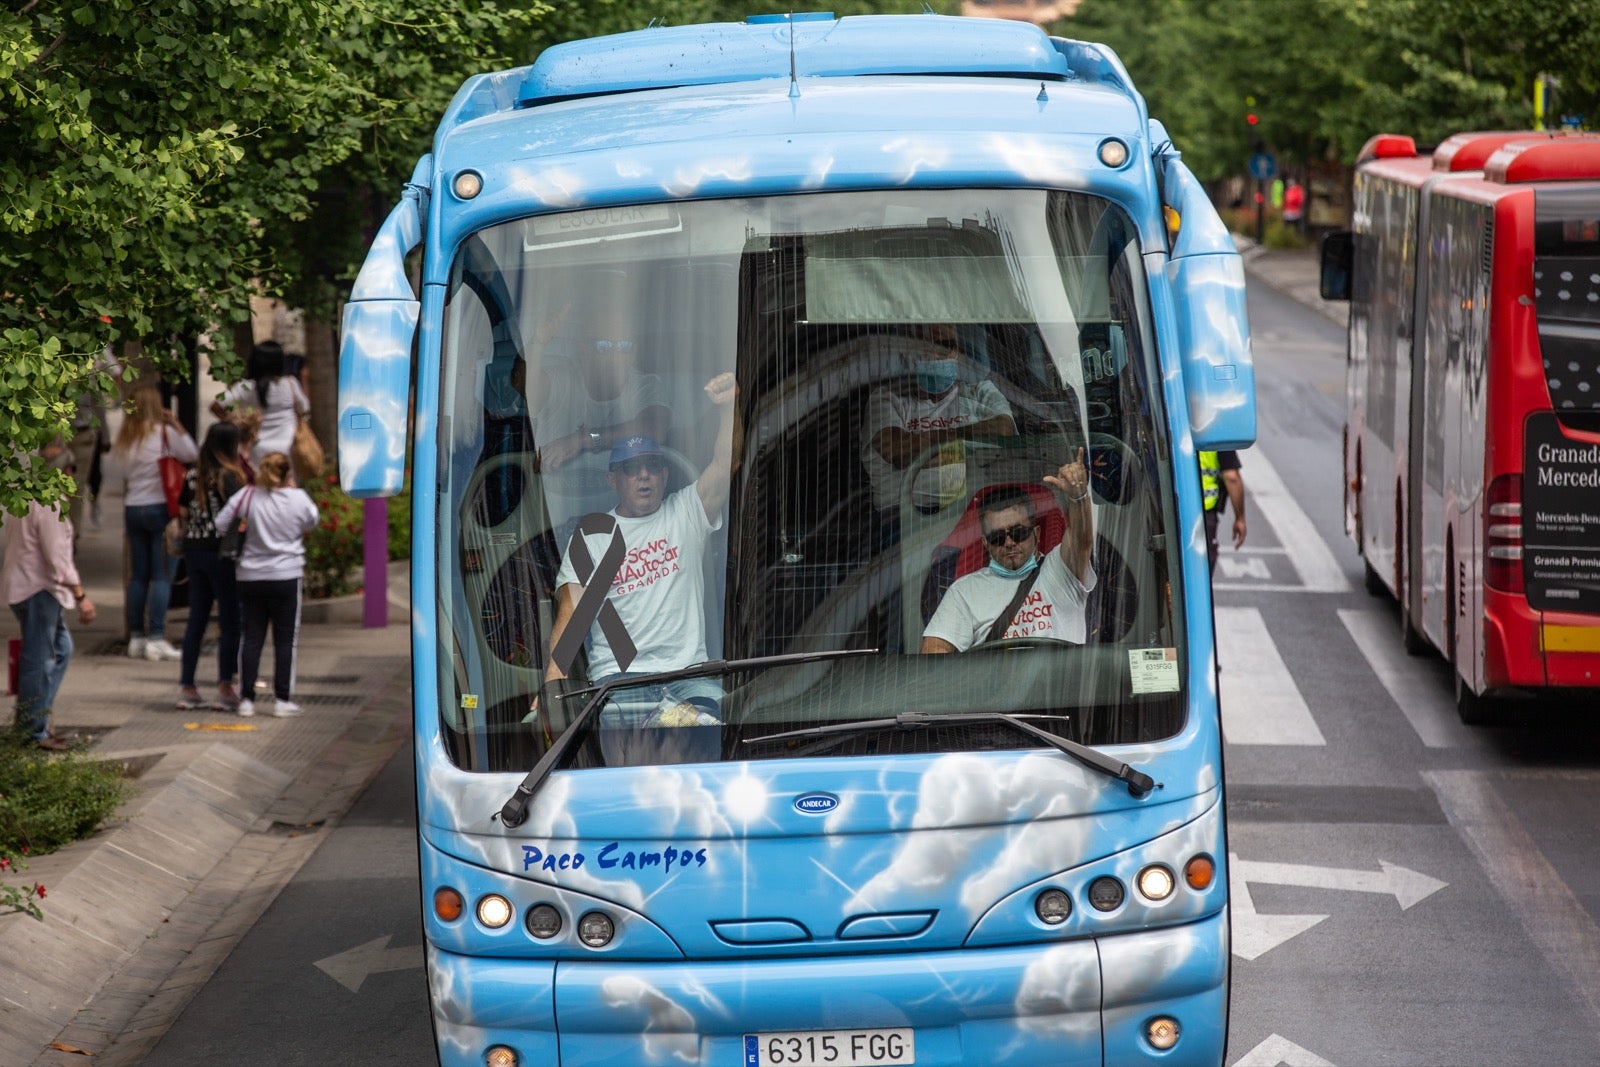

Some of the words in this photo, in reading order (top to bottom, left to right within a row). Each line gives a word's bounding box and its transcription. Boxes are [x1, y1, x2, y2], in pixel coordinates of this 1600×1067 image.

[558, 206, 645, 229] ESCOLAR
[1538, 443, 1600, 464] Granad
[1538, 466, 1600, 488] Merced
[616, 562, 681, 596] GRANADA
[801, 800, 832, 808] ANDECAR
[521, 844, 585, 872] Paco
[597, 842, 708, 874] Campos
[768, 1036, 839, 1064] 6315
[850, 1033, 904, 1061] FGG
